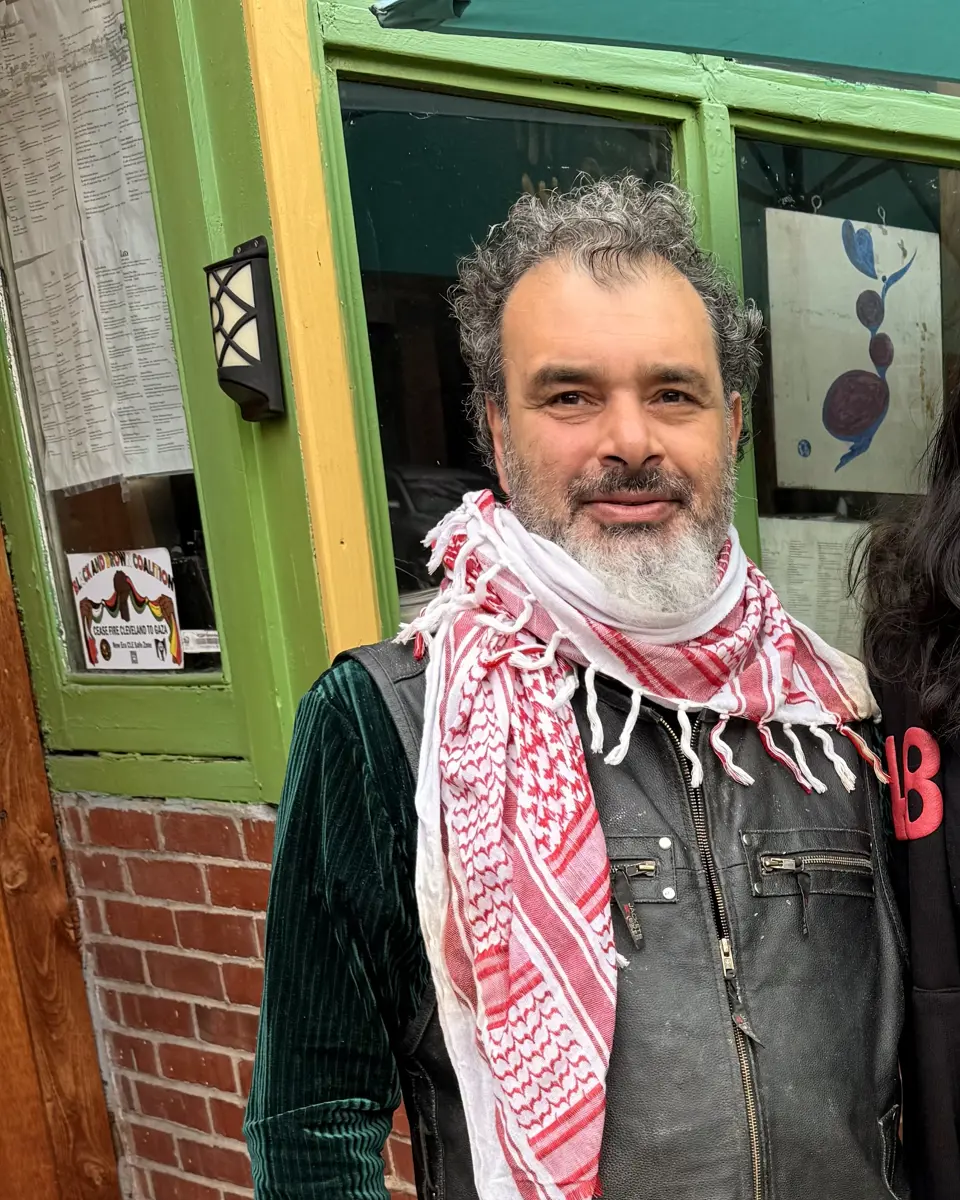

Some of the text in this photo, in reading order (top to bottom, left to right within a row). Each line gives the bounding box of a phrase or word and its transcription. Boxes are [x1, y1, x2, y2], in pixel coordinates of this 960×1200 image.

[91, 553, 105, 576] AND
[132, 553, 174, 591] COALITION
[93, 625, 168, 635] CEASE FIRE CLEVELAND TO GAZA
